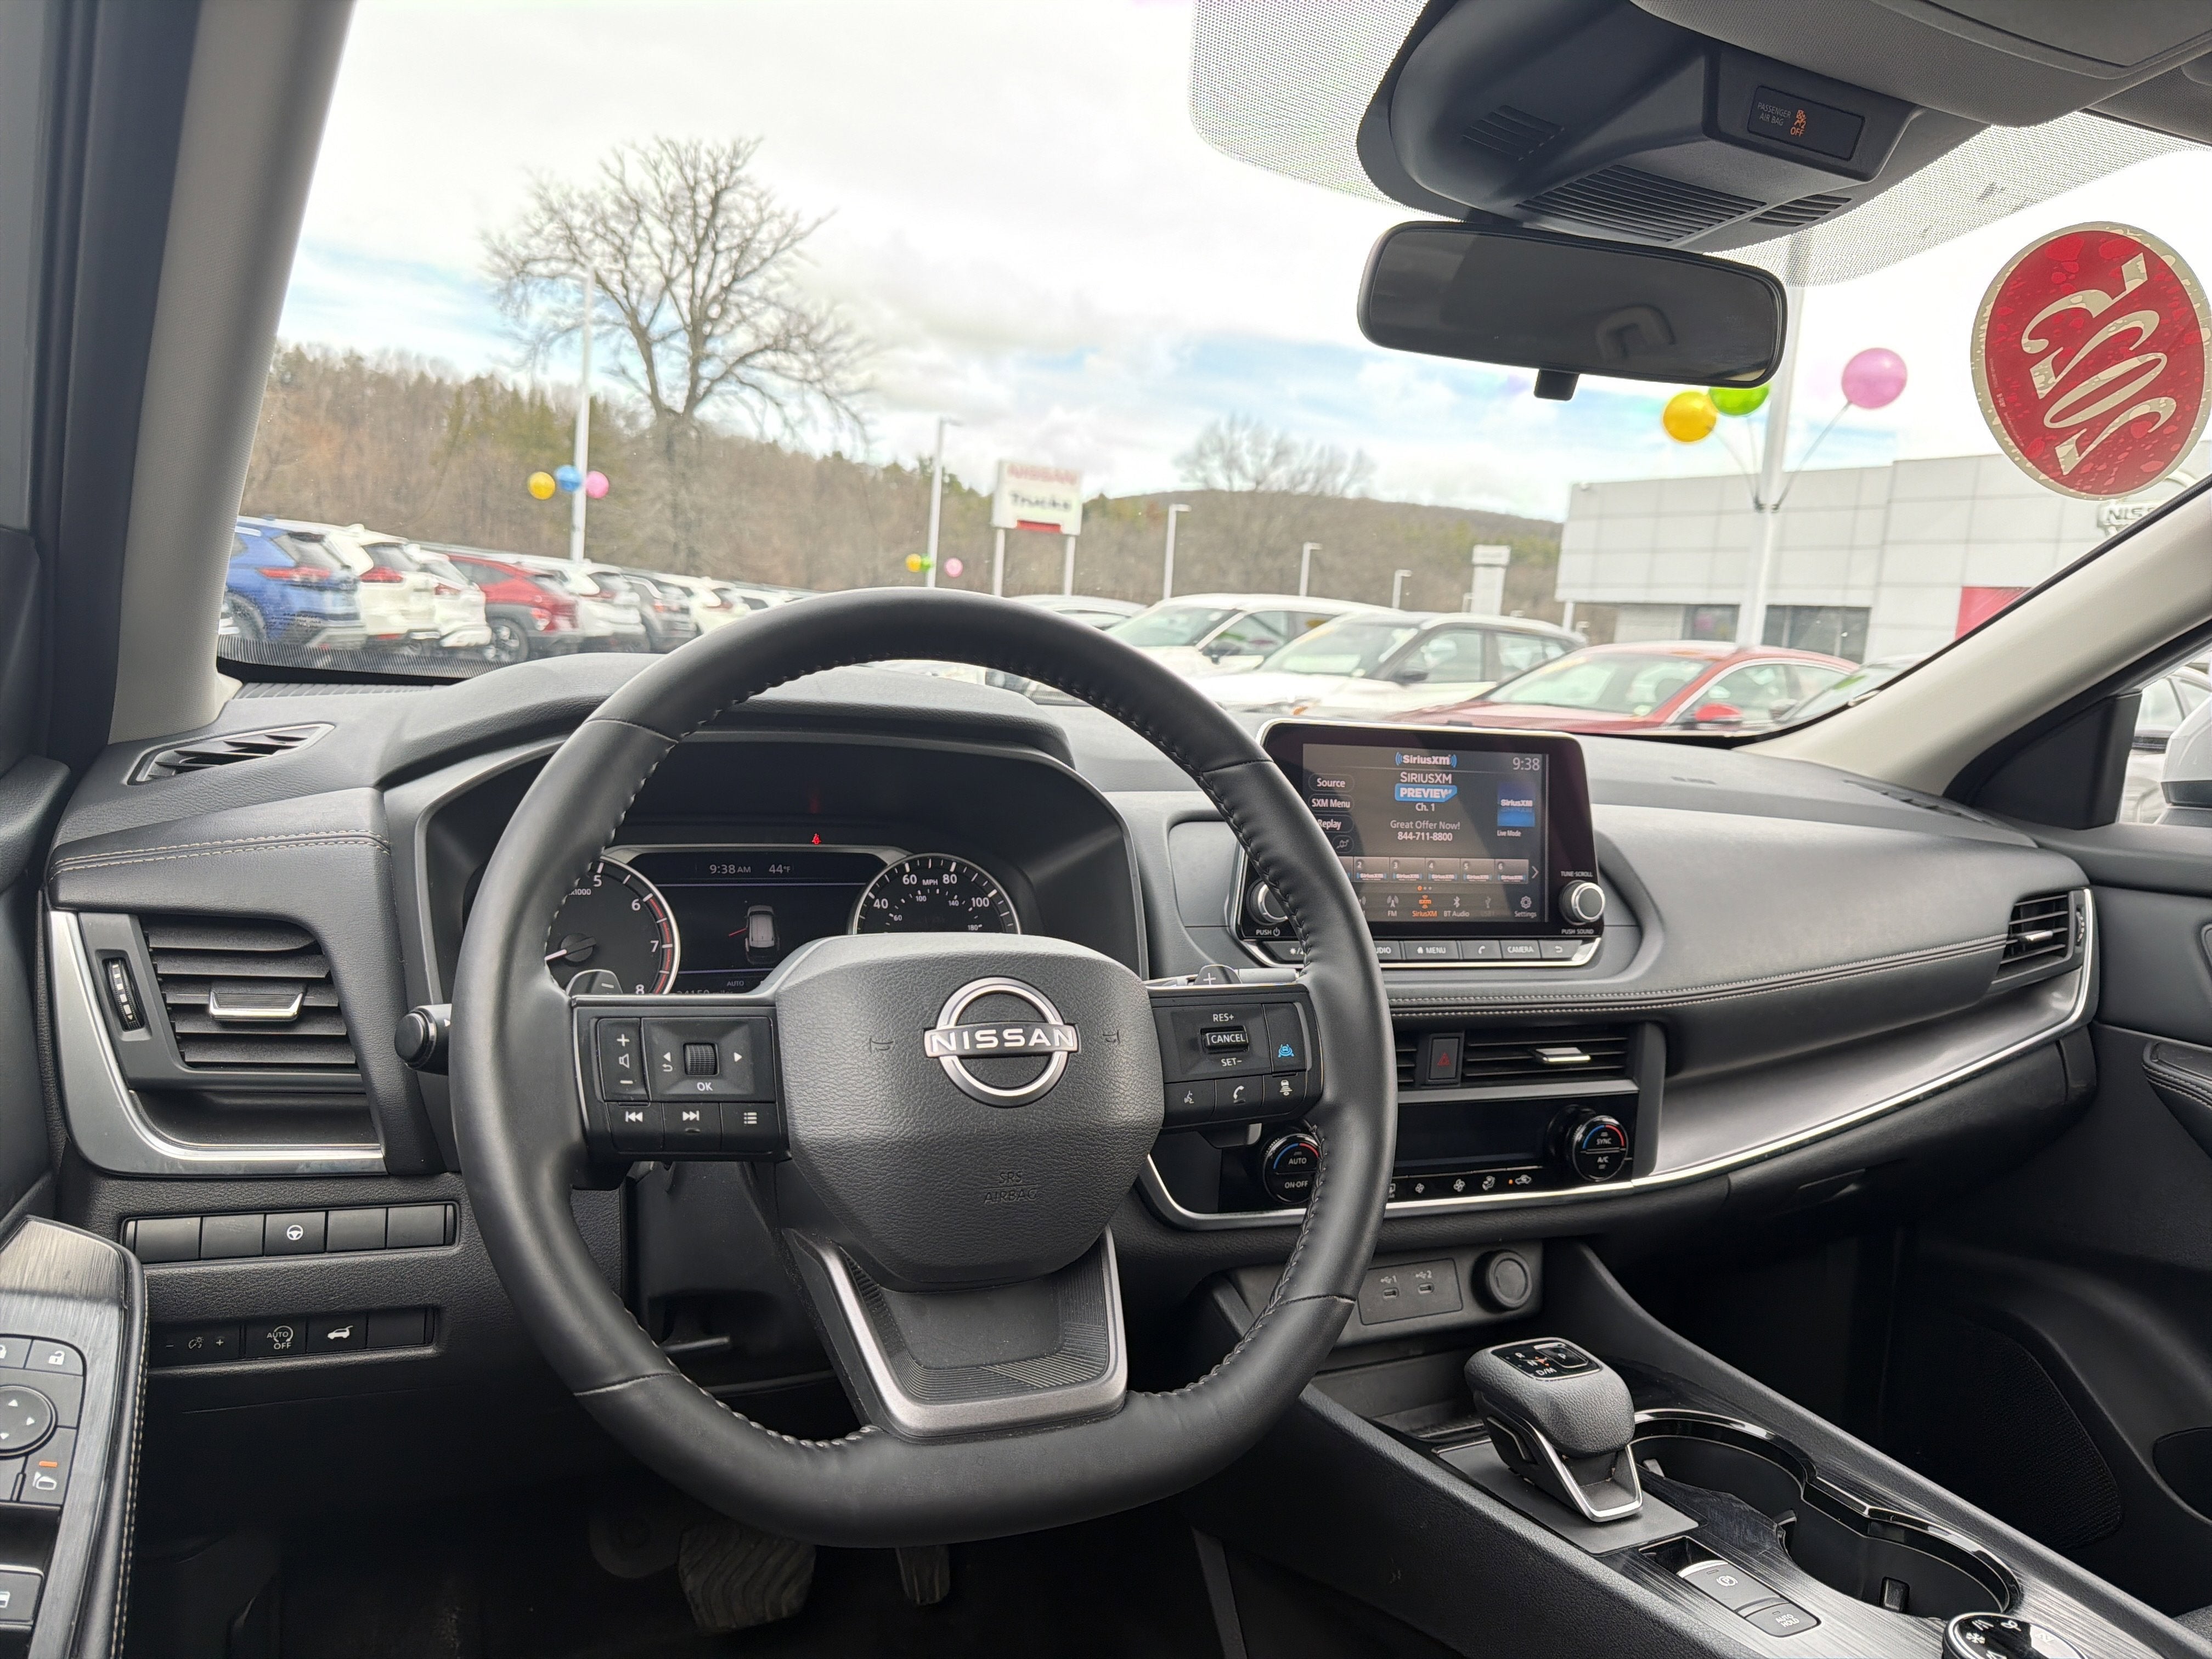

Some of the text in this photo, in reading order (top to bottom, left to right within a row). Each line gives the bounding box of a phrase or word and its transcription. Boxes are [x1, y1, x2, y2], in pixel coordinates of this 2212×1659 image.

[1757, 101, 1792, 119] PASSENGER
[1759, 112, 1784, 126] AIR BAG
[1790, 127, 1804, 137] OFF
[1513, 757, 1541, 771] 9:38
[1317, 778, 1346, 788] Source
[1400, 787, 1453, 799] PREVIEW
[1312, 798, 1351, 809] SXM Menu
[1415, 803, 1435, 812] Ch. 1
[1317, 819, 1342, 830] Replay
[1390, 819, 1460, 831] Great Offer Now!
[1397, 832, 1453, 842] 844-711-8800
[1497, 829, 1506, 837] Live
[709, 864, 736, 874] 9:38
[593, 875, 602, 887] 5
[902, 874, 917, 885] 60
[942, 873, 957, 884] 80
[631, 899, 641, 911] 6
[873, 898, 889, 909] 40
[971, 897, 990, 907] 100
[650, 940, 659, 952] 7
[635, 984, 645, 995] 8
[931, 1028, 1074, 1053] NISSAN
[1211, 1034, 1245, 1043] CANCEL
[697, 1082, 713, 1091] OK
[1596, 1137, 1612, 1146] SYNC
[1288, 1157, 1307, 1165] AUTO
[998, 1171, 1023, 1184] SRS
[983, 1189, 1038, 1205] AIRBAG
[1426, 1270, 1432, 1278] 2
[1775, 1614, 1793, 1623] AUTO
[1781, 1618, 1799, 1627] HOLD
